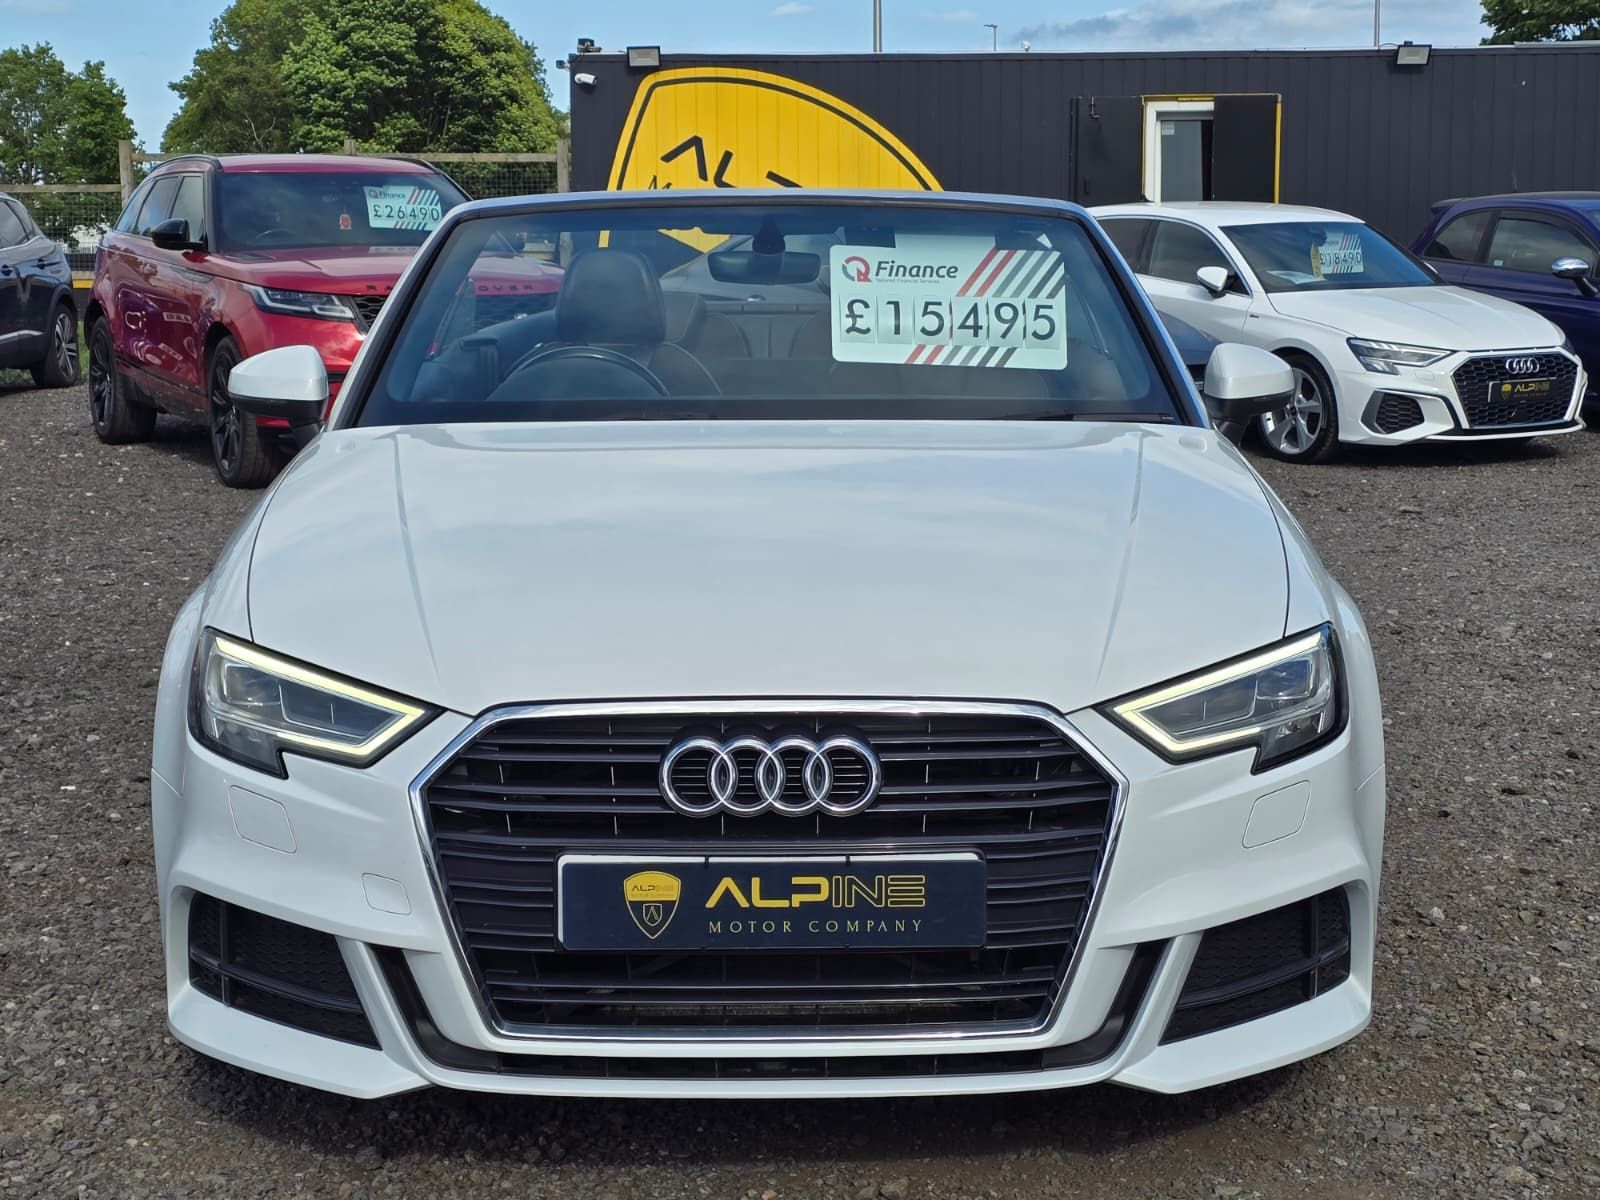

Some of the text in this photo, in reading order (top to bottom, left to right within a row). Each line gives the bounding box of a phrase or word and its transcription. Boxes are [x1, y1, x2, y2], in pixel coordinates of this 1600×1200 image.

[379, 190, 406, 199] Finance
[373, 204, 440, 222] £26490
[875, 260, 959, 279] Finance
[478, 284, 533, 292] OVER
[845, 298, 1057, 342] £15495
[704, 874, 926, 909] ALPINE
[708, 918, 923, 934] MOTOR COMPANY
